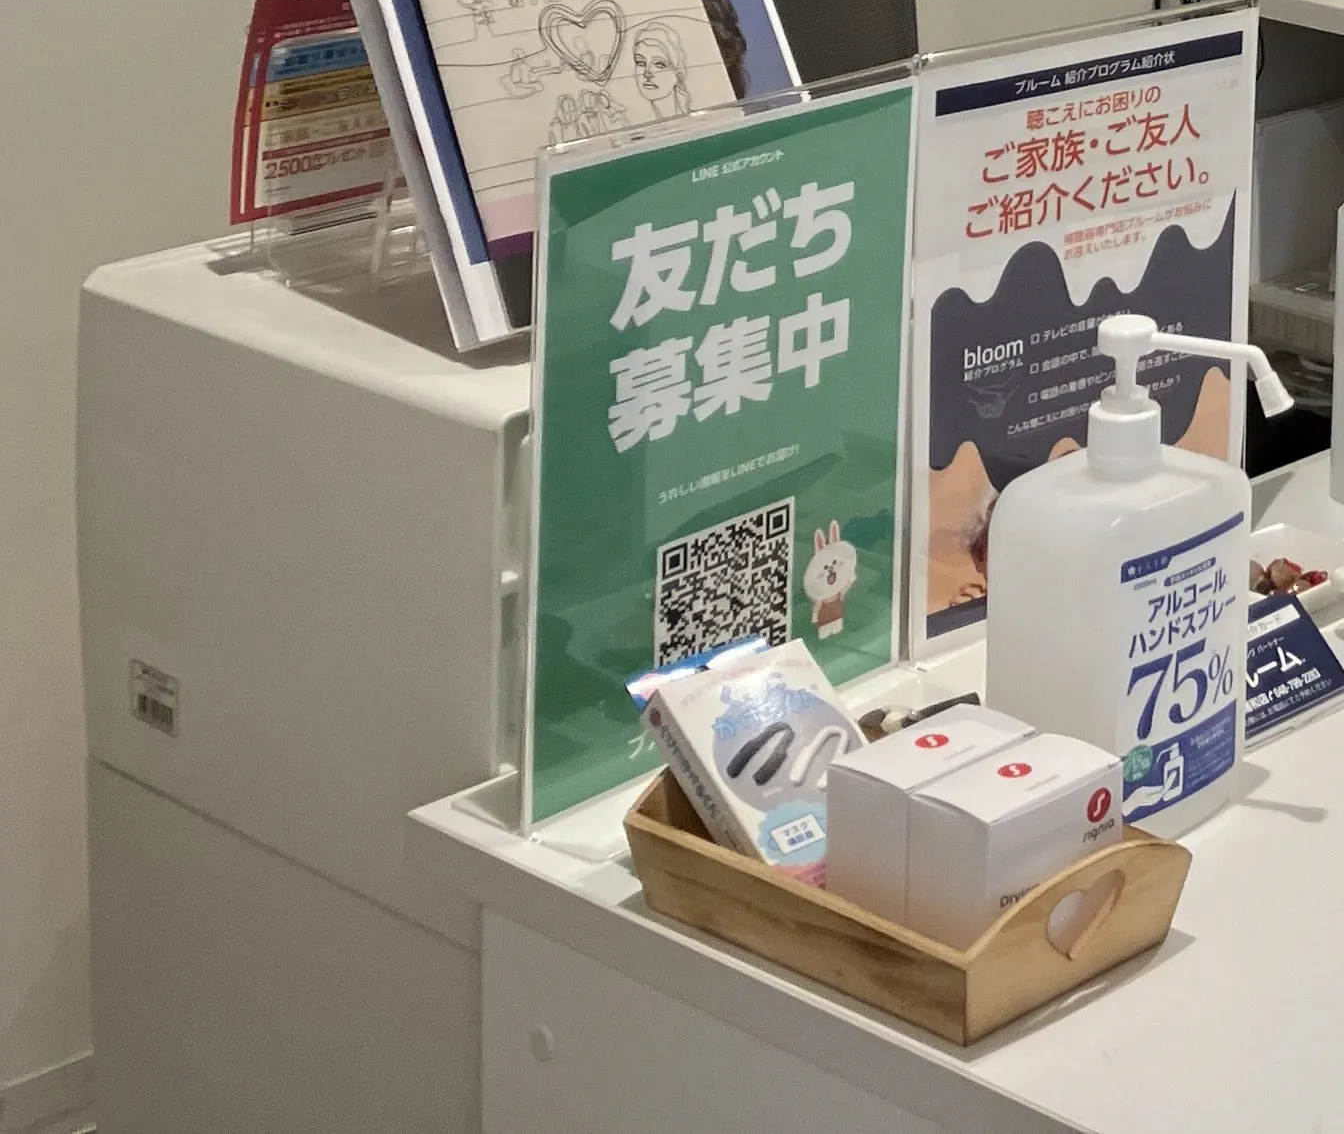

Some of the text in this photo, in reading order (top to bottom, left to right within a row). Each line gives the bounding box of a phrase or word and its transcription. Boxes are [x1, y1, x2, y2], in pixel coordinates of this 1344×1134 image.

[1015, 49, 1176, 95] ブルーム 紹介プログラム紹介状
[1026, 85, 1161, 131] 聴こえにお困りの
[691, 165, 720, 183] LINE
[980, 102, 1202, 185] ご家族・ご友人
[964, 154, 1210, 240] ご紹介ください。
[609, 179, 856, 332] 友だち
[607, 290, 853, 454] 募集中
[963, 338, 1025, 370] bloom
[1128, 595, 1237, 659] ハンドスプレー
[1148, 566, 1227, 624] アルコール
[1125, 637, 1235, 742] 75%
